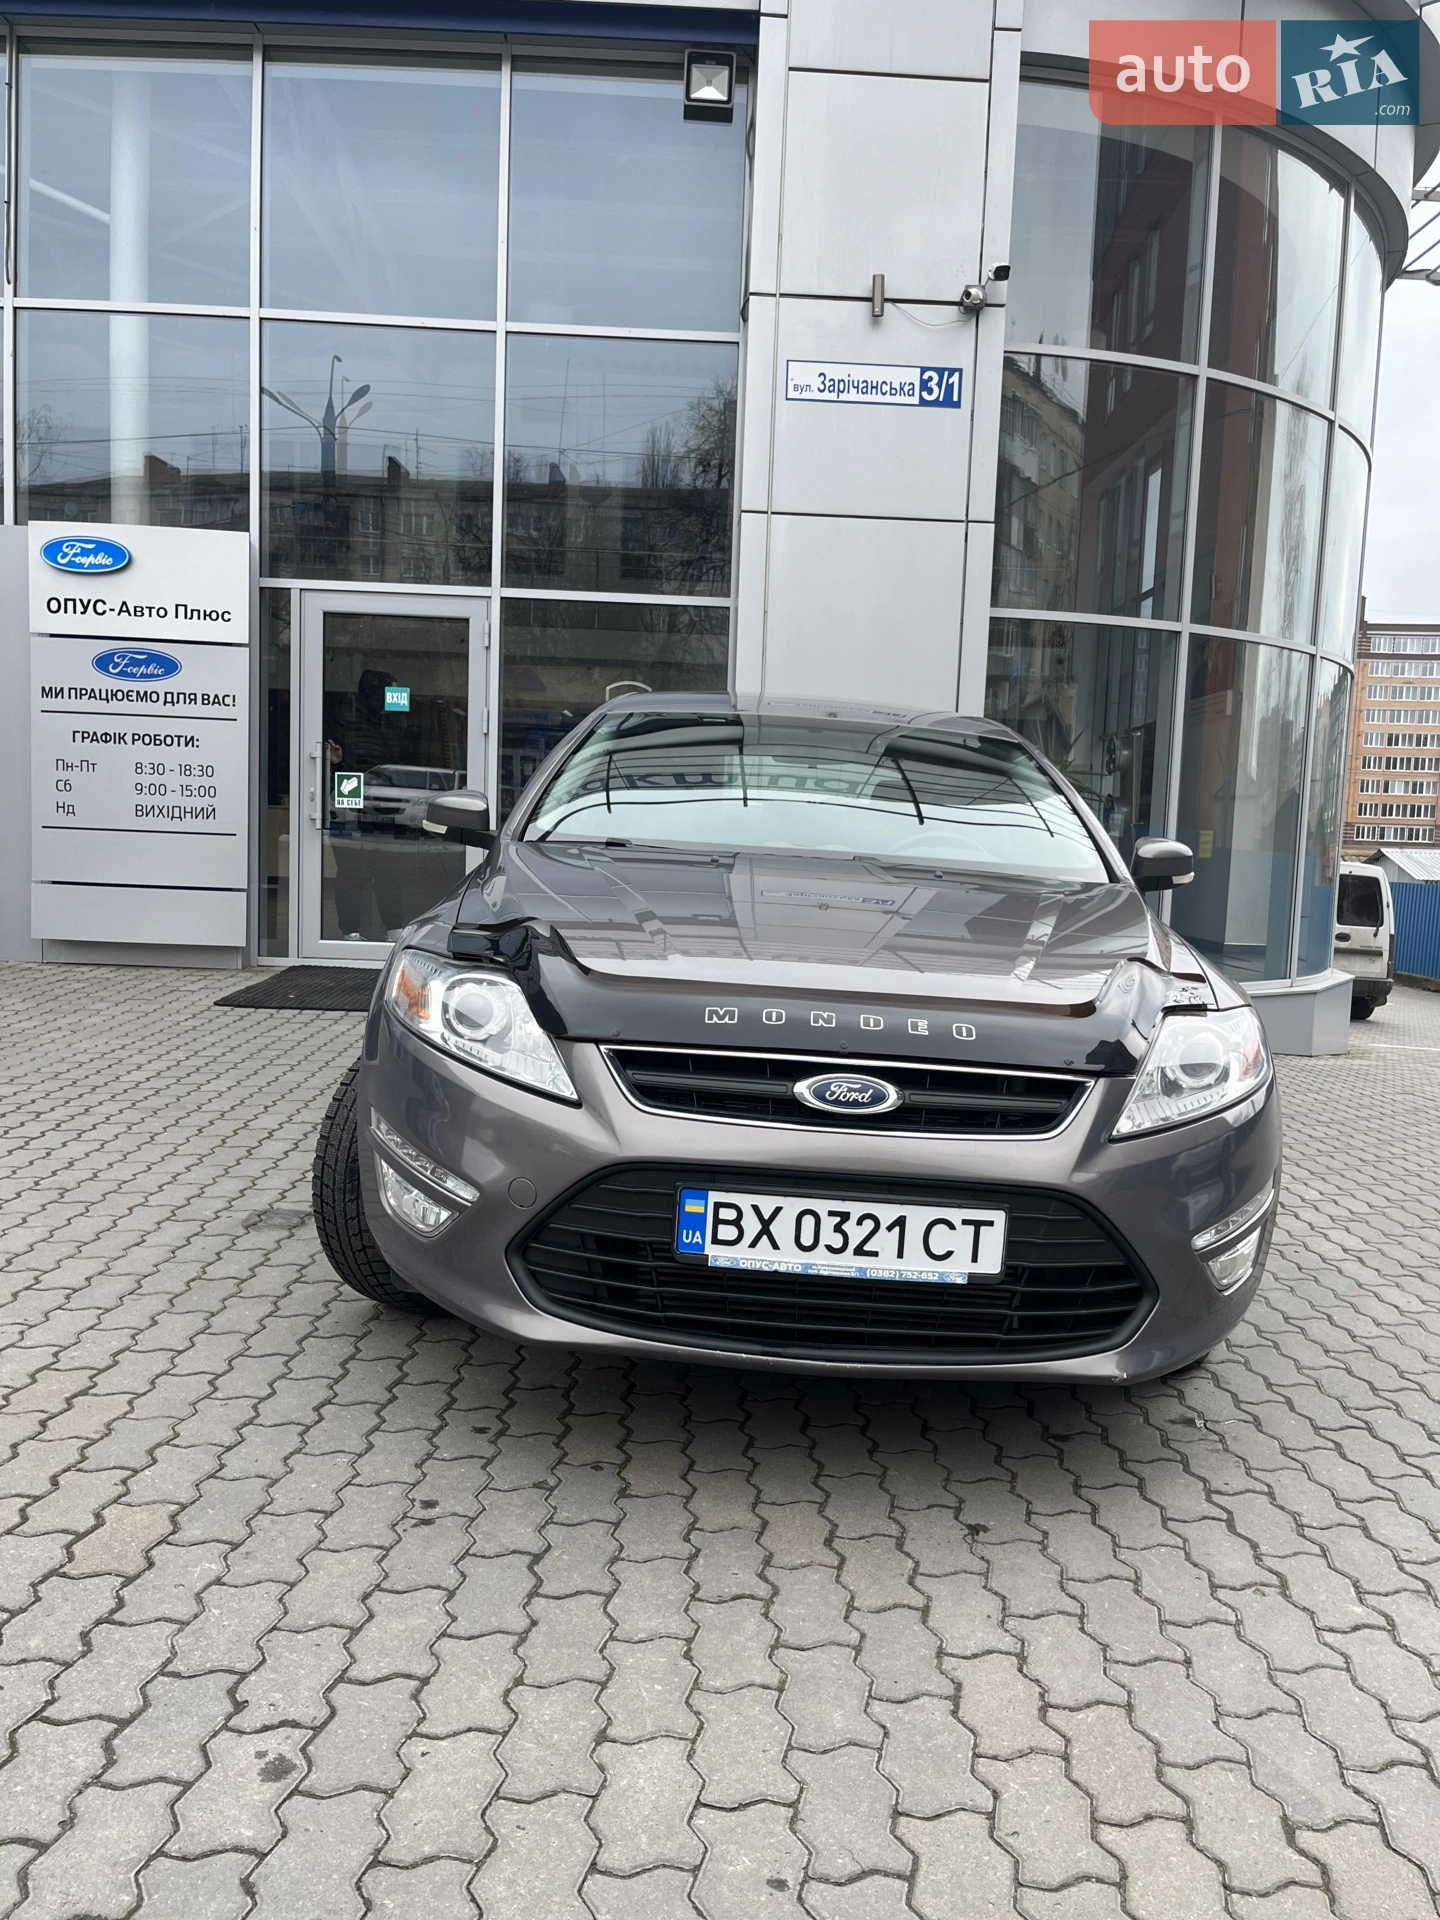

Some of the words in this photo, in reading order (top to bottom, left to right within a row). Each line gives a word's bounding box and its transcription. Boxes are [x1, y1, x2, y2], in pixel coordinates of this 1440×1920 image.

[793, 383, 814, 395] вул.
[817, 372, 915, 398] Зарічанська
[920, 370, 960, 402] 3/1
[46, 597, 168, 619] ОПУС-Авто
[174, 603, 232, 623] Плюс
[41, 686, 64, 699] МИ
[67, 687, 160, 704] ПРАЦЮЄМО
[163, 691, 198, 706] ДЛЯ
[201, 693, 236, 707] ВАС!
[386, 692, 408, 706] ВХІД
[72, 730, 128, 745] ГРАФІК
[131, 732, 200, 748] РОБОТИ:
[55, 758, 97, 773] Пн-Пт
[134, 762, 166, 776] 8:30
[177, 763, 215, 778] 18:30
[55, 779, 72, 793] Сб
[134, 782, 167, 797] 9:00
[179, 784, 217, 798] 15:00
[55, 801, 76, 816] Нд
[134, 804, 217, 821] ВИХІДНИЙ
[705, 1006, 976, 1040] MONDEO
[825, 1082, 872, 1104] Ford
[682, 1230, 703, 1245] UA
[739, 1258, 802, 1272] ОПУС-АВТО
[866, 1268, 900, 1280] (0382)
[901, 1270, 939, 1281] 752-652
